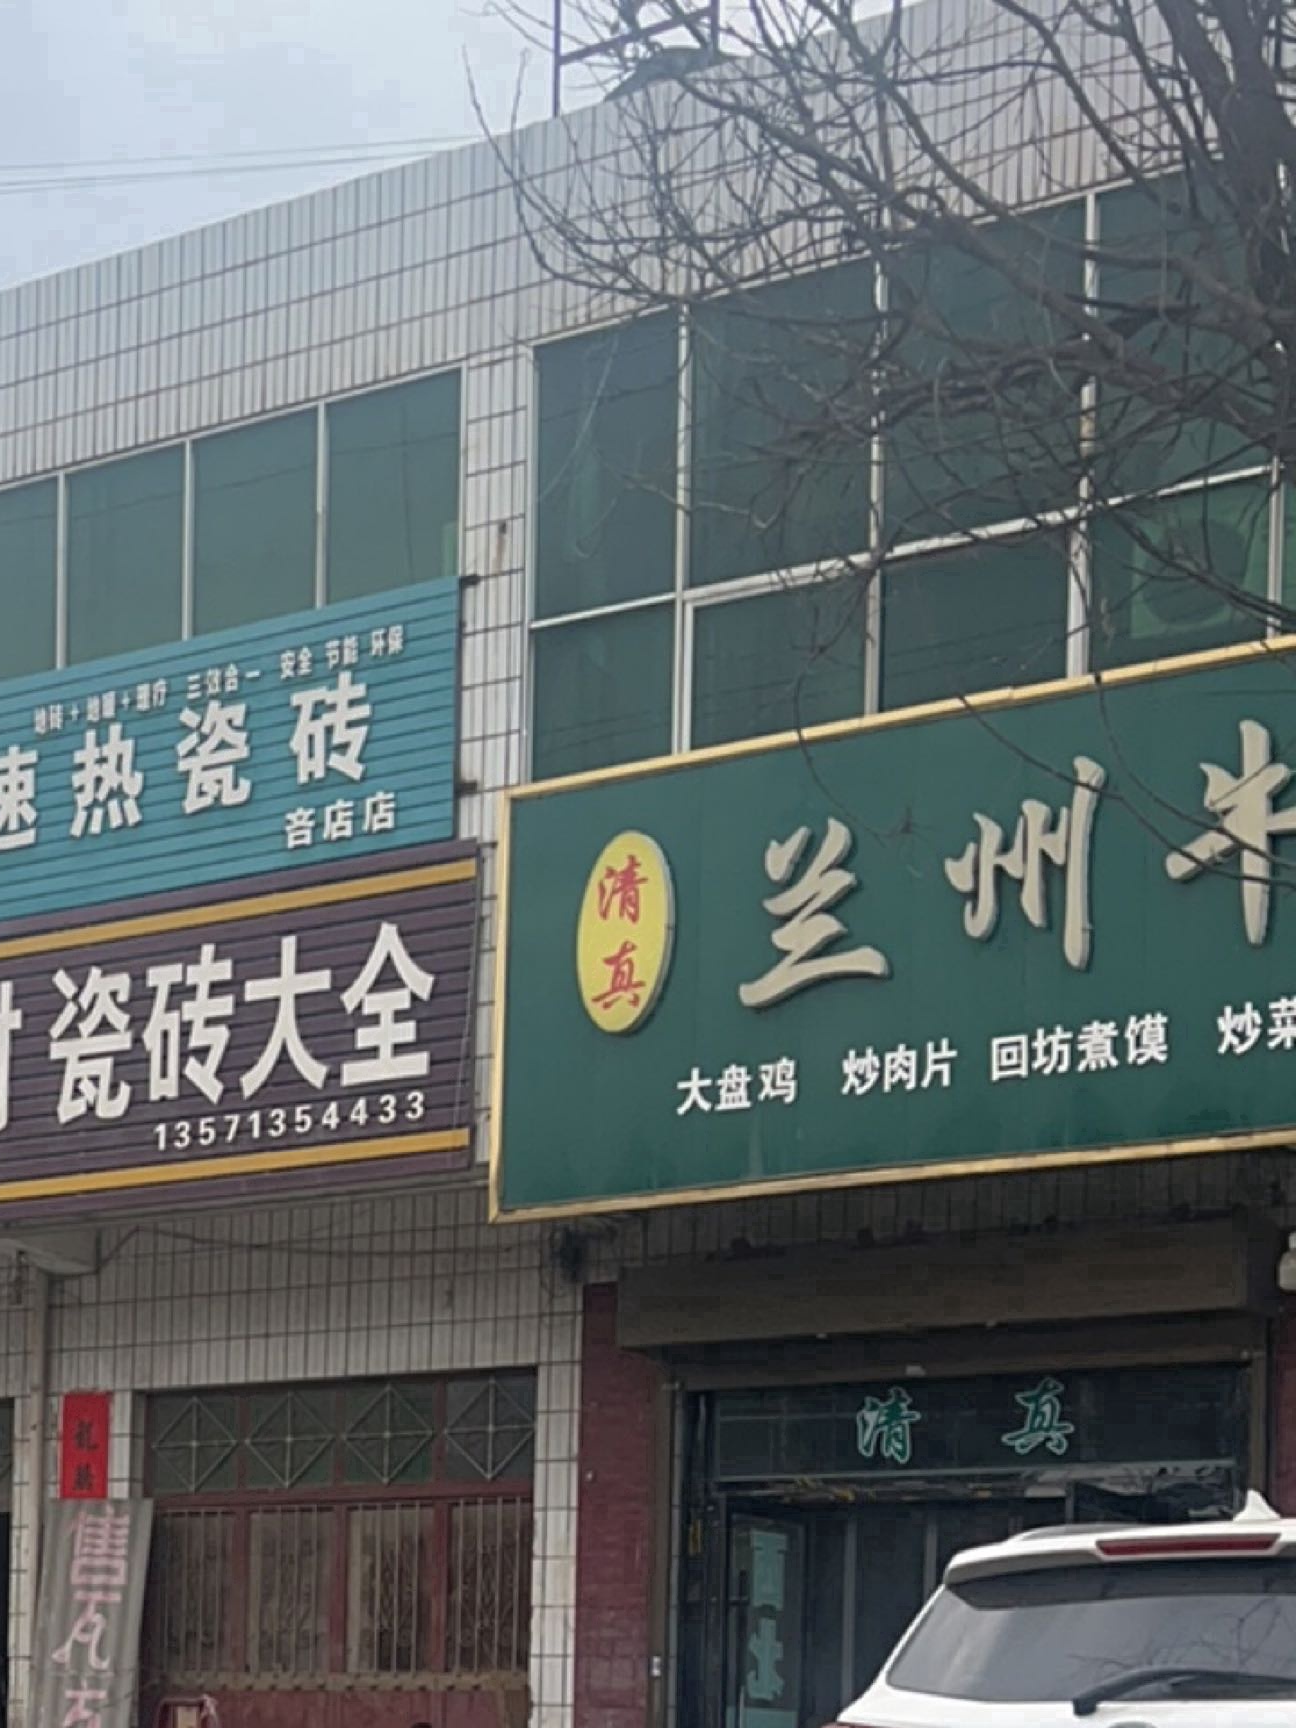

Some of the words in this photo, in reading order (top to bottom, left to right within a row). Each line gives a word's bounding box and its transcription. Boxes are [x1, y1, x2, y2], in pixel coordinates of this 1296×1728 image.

[280, 646, 312, 680] 安全
[324, 633, 359, 668] 节能
[370, 624, 404, 657] 环保
[594, 854, 648, 1011] 清真
[48, 921, 436, 1125] 瓷砖大全
[676, 1057, 799, 1116] 大盘鸡
[840, 1037, 959, 1097] 炒肉片
[990, 1012, 1170, 1083] 回坊煮馍
[153, 1091, 427, 1151] 13571354433
[855, 1375, 1075, 1464] 清真
